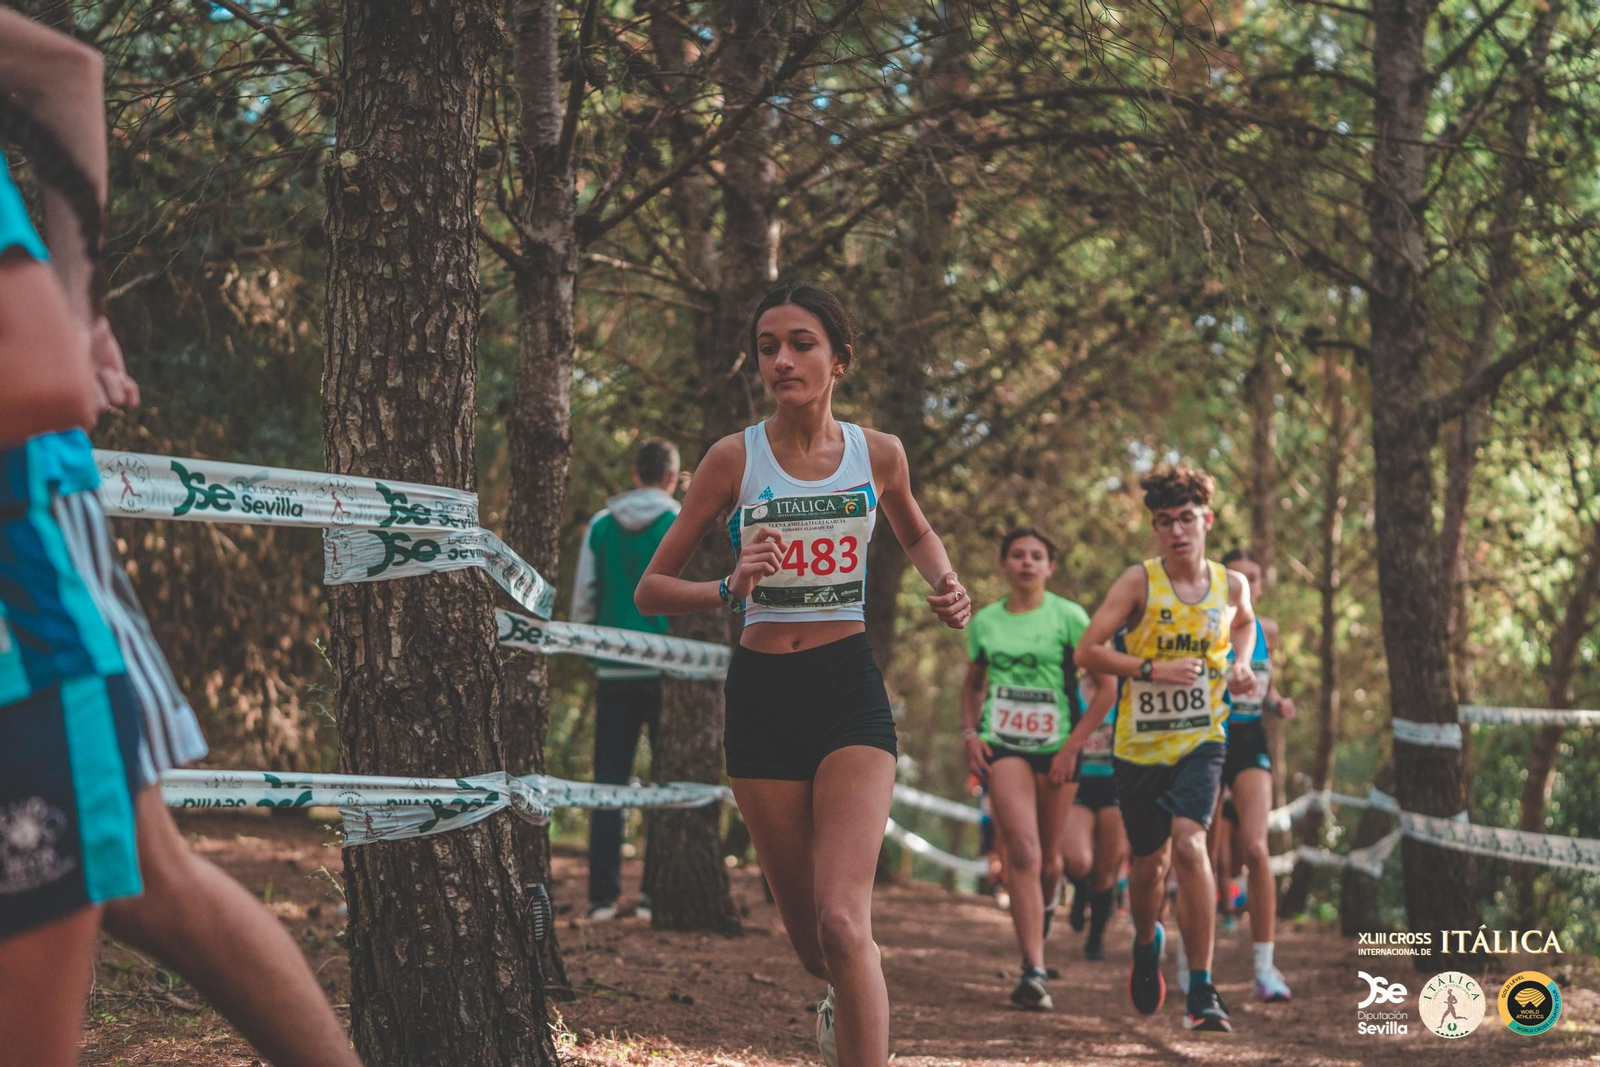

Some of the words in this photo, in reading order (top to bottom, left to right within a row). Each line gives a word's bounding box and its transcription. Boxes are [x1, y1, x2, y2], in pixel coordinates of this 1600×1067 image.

[241, 494, 303, 518] Sevilla
[777, 498, 836, 514] ITÁLICA
[1139, 688, 1206, 714] 8108
[998, 708, 1054, 733] 7463
